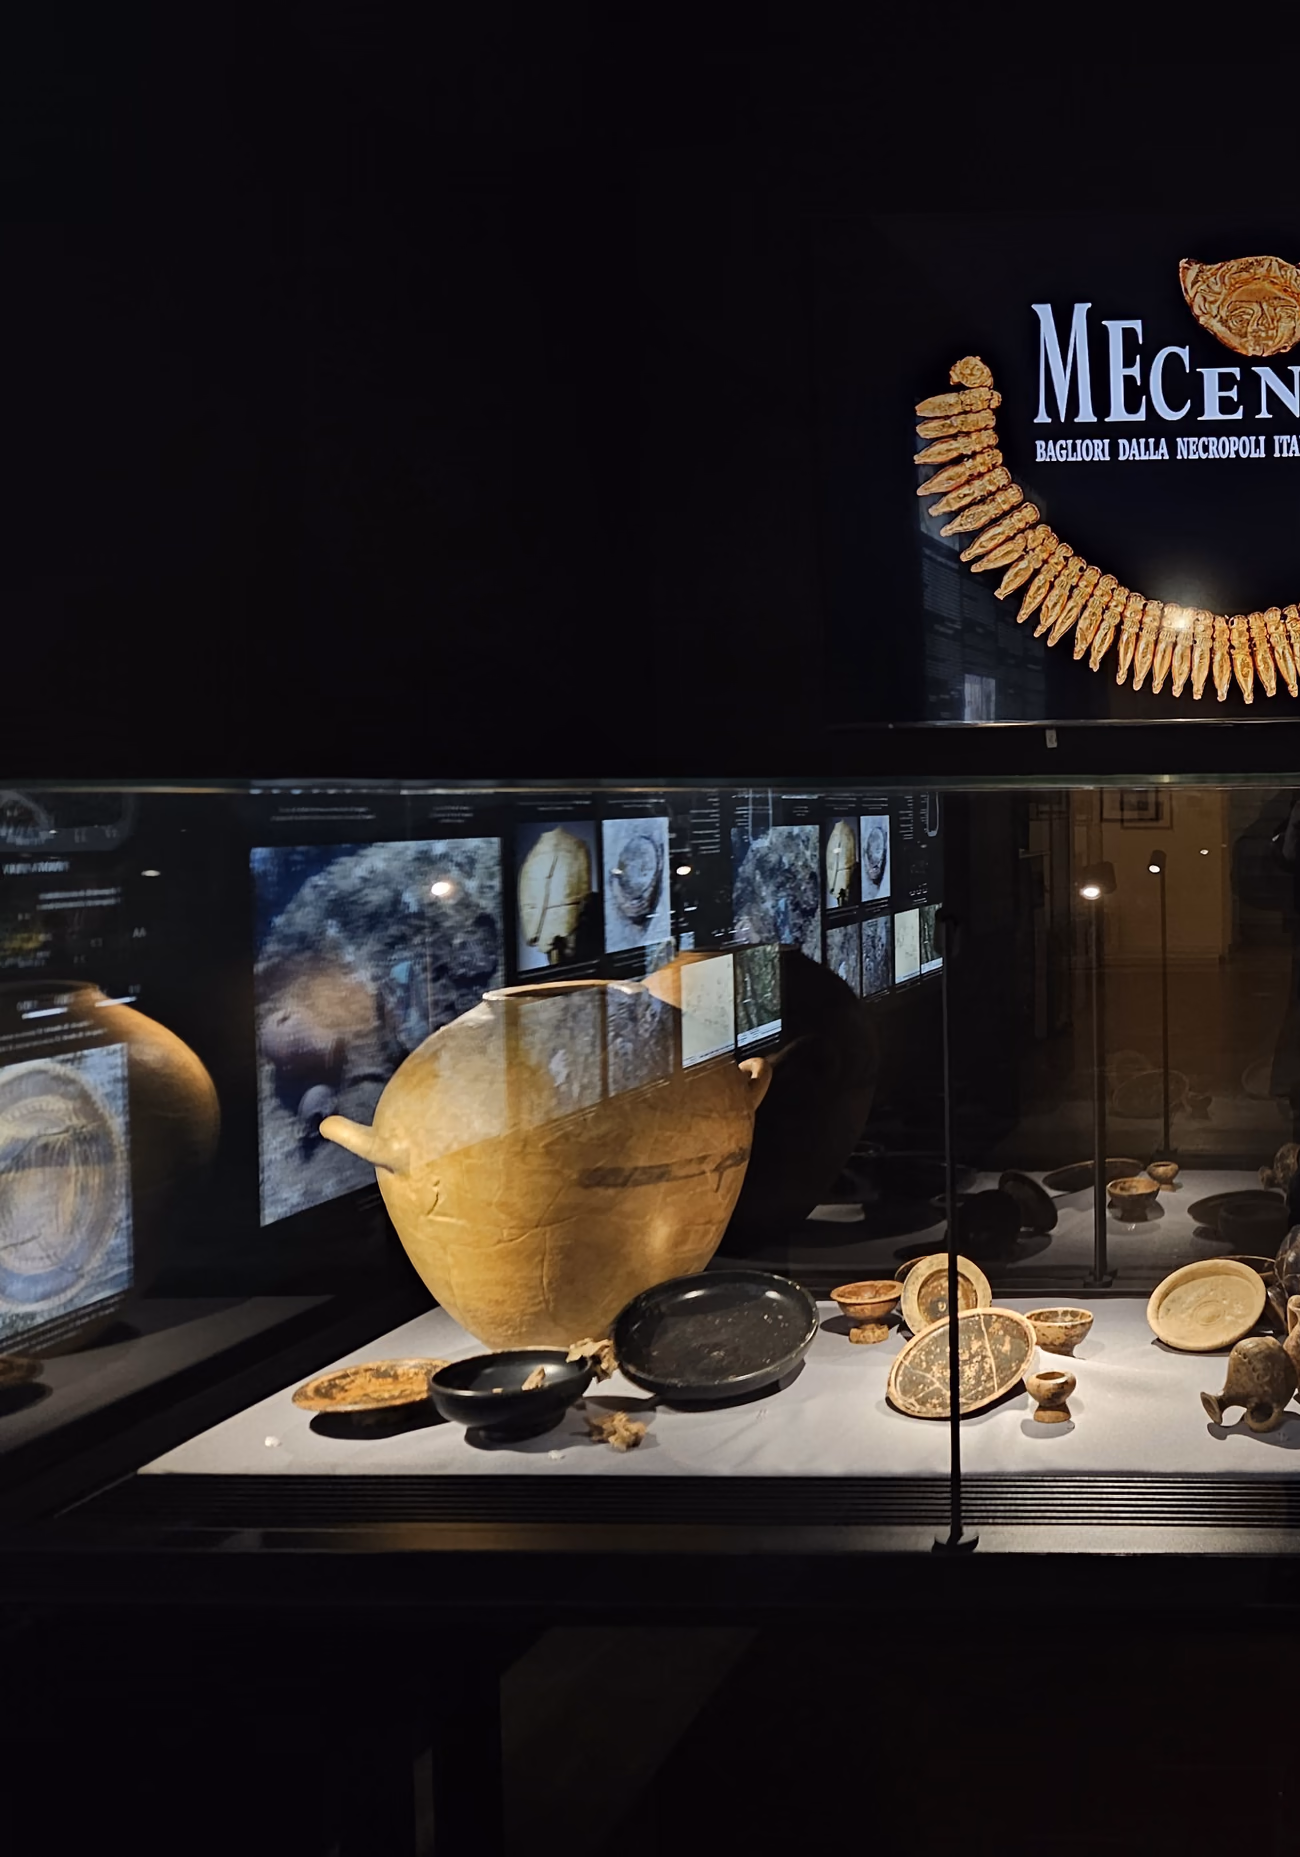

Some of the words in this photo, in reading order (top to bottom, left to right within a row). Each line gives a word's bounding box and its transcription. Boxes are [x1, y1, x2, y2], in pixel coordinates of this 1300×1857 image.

[1035, 438, 1110, 462] BAGLIORI
[1117, 437, 1170, 460] DALLA
[1175, 435, 1266, 459] NECROPOLI
